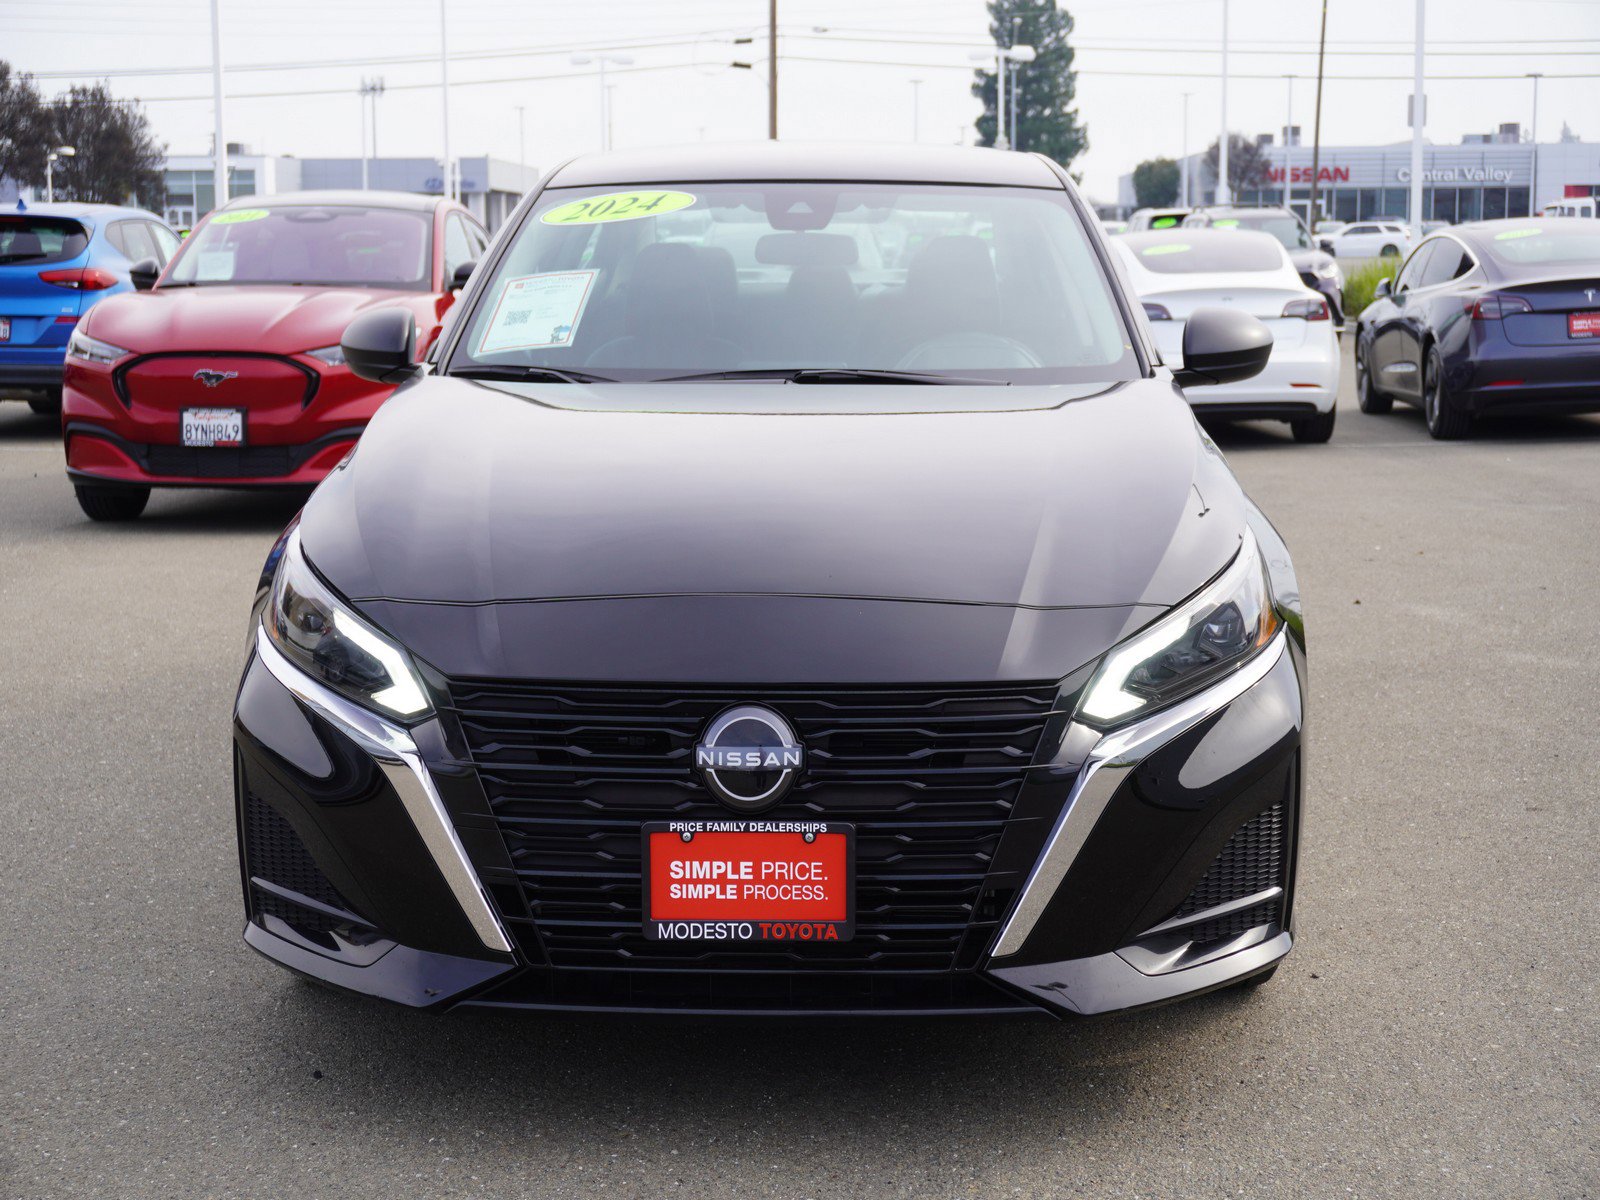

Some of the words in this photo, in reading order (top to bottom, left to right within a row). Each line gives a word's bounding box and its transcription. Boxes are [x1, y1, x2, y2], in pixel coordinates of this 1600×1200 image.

[1263, 166, 1350, 183] NISSAN
[1397, 166, 1459, 183] Cntral
[1463, 166, 1513, 184] Valley
[561, 193, 668, 222] 2024
[185, 423, 240, 441] 8YNH849
[698, 750, 800, 767] NISSAN
[669, 822, 703, 832] PRICE
[706, 822, 746, 832] FAMILY
[749, 823, 828, 833] DEALERSHIPS
[669, 860, 754, 880] SIMPLE
[761, 861, 829, 880] PRICE.
[669, 883, 738, 900] SIMPLE
[743, 884, 829, 901] PROCESS.
[658, 922, 753, 940] MODESTO
[759, 922, 839, 940] TOYOTA
